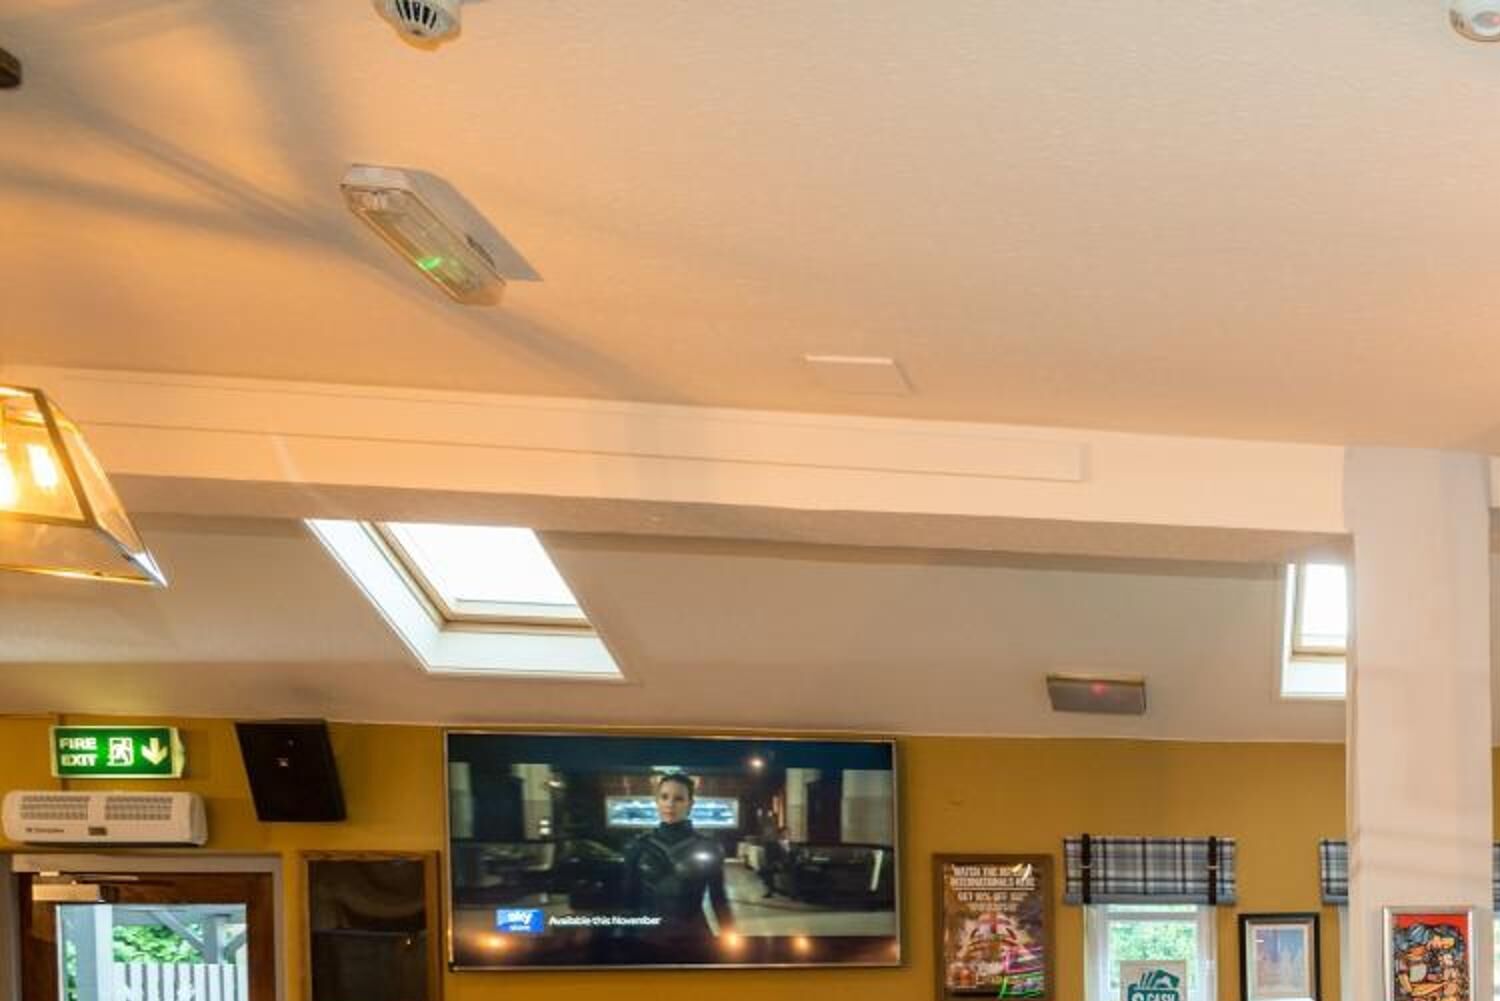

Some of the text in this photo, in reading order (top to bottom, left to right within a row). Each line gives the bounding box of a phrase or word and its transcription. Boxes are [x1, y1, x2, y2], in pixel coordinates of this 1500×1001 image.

[59, 737, 97, 750] FIRE
[61, 753, 97, 766] EXIT
[507, 910, 532, 925] sky
[549, 914, 662, 926] Available this November
